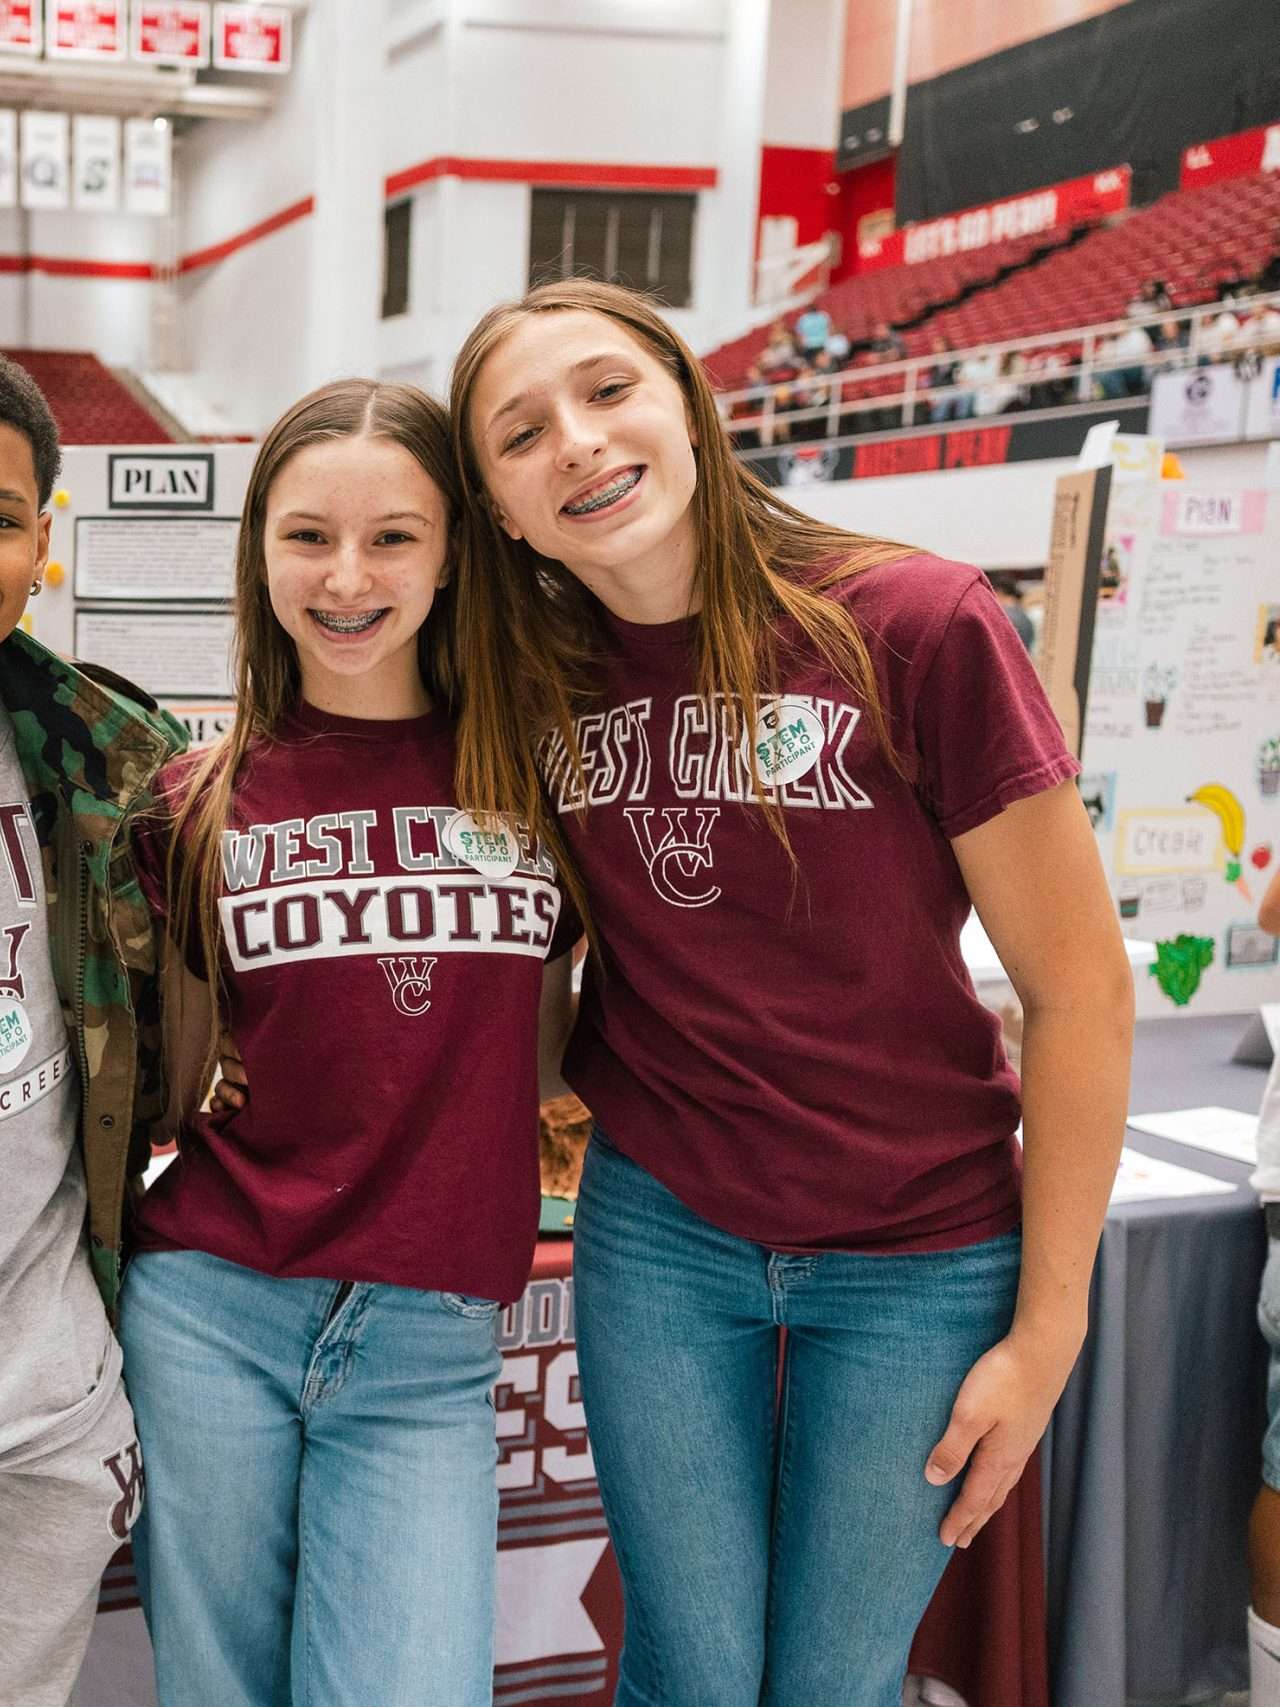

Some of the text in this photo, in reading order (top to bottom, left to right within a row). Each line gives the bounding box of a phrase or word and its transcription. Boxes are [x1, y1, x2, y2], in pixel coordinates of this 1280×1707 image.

[124, 469, 199, 495] PLAN
[756, 718, 808, 760] STEM
[763, 734, 811, 768] EXPO
[765, 741, 817, 777] PARTICIPANT
[221, 809, 376, 891] WEST
[460, 831, 507, 846] STEM
[465, 845, 509, 855] EXPO
[623, 807, 722, 907] WC
[232, 884, 556, 960] COYOTES
[377, 957, 438, 1016] WC
[0, 1056, 68, 1111] CREE
